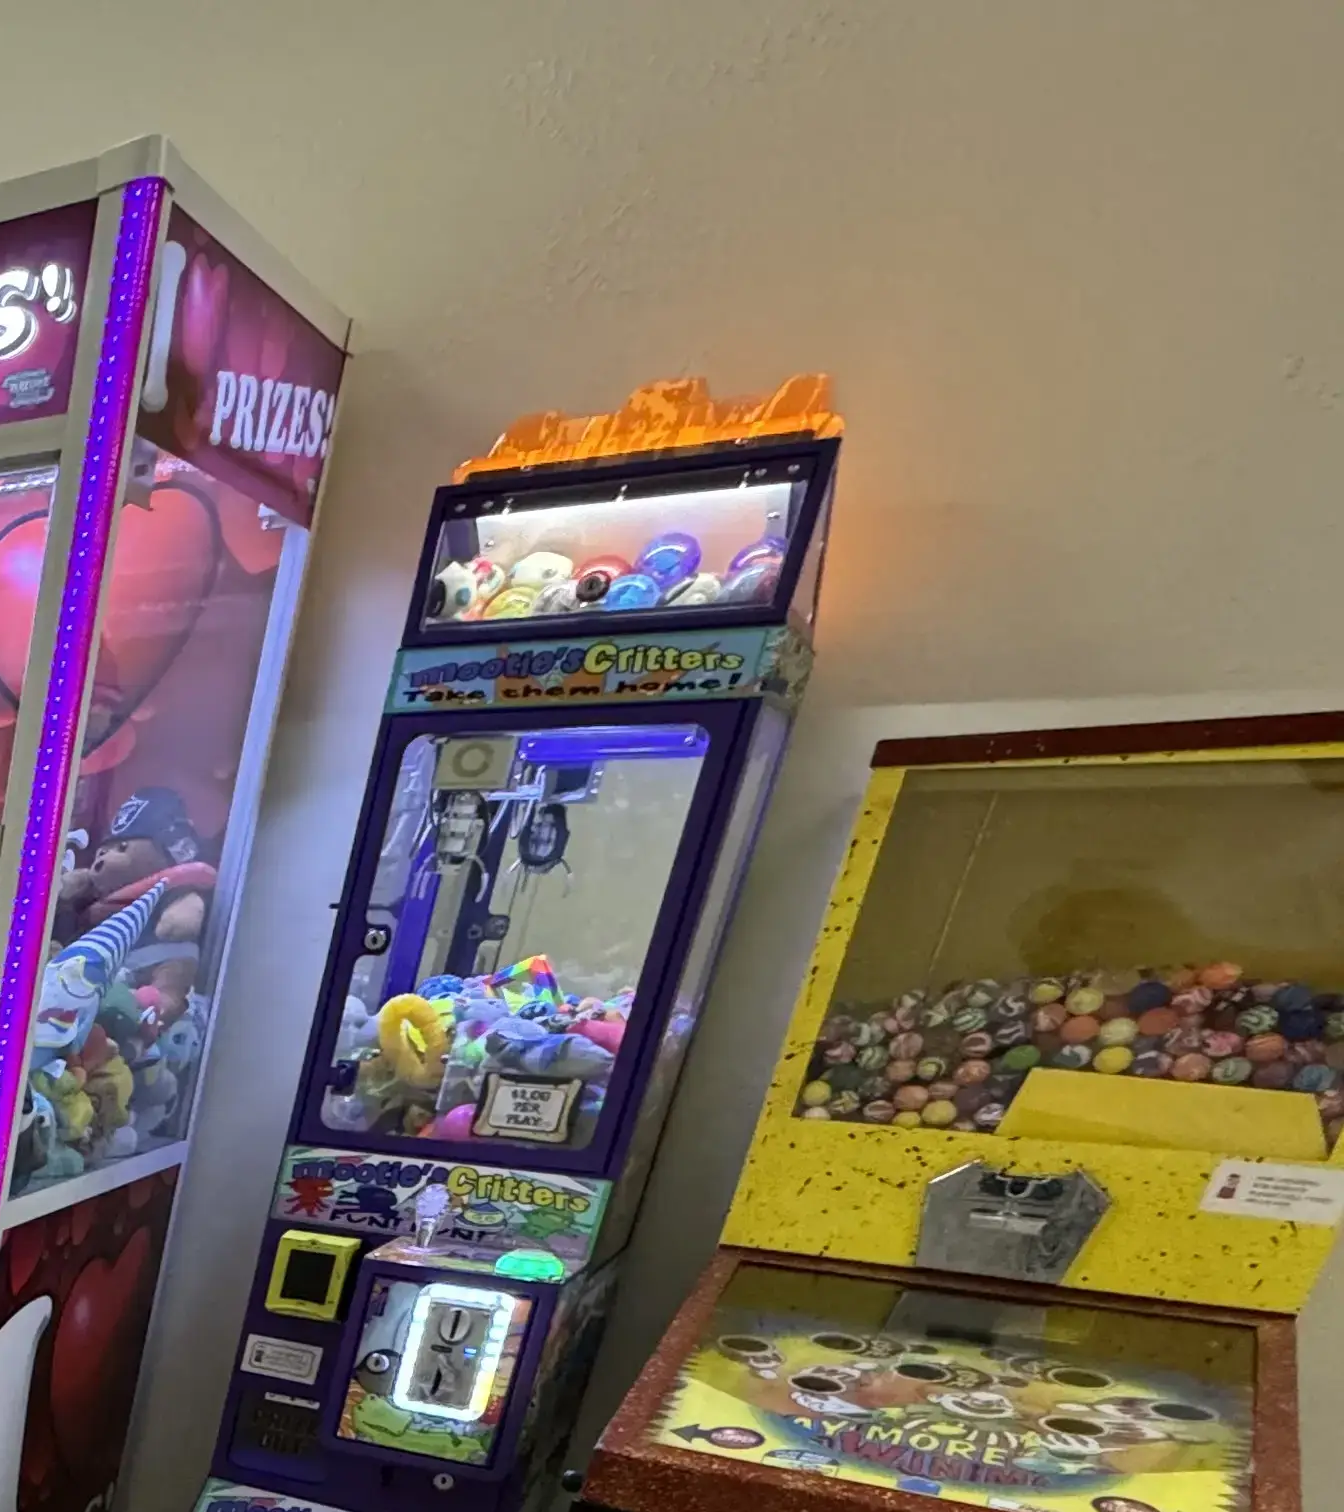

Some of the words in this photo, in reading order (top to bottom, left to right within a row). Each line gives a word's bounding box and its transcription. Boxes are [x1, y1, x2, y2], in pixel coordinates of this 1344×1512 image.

[209, 369, 338, 460] PRIZES!
[582, 639, 746, 675] Critters
[501, 683, 600, 699] them
[614, 671, 742, 694] home!
[446, 1164, 592, 1214] Critters
[866, 1424, 1010, 1466] MORE
